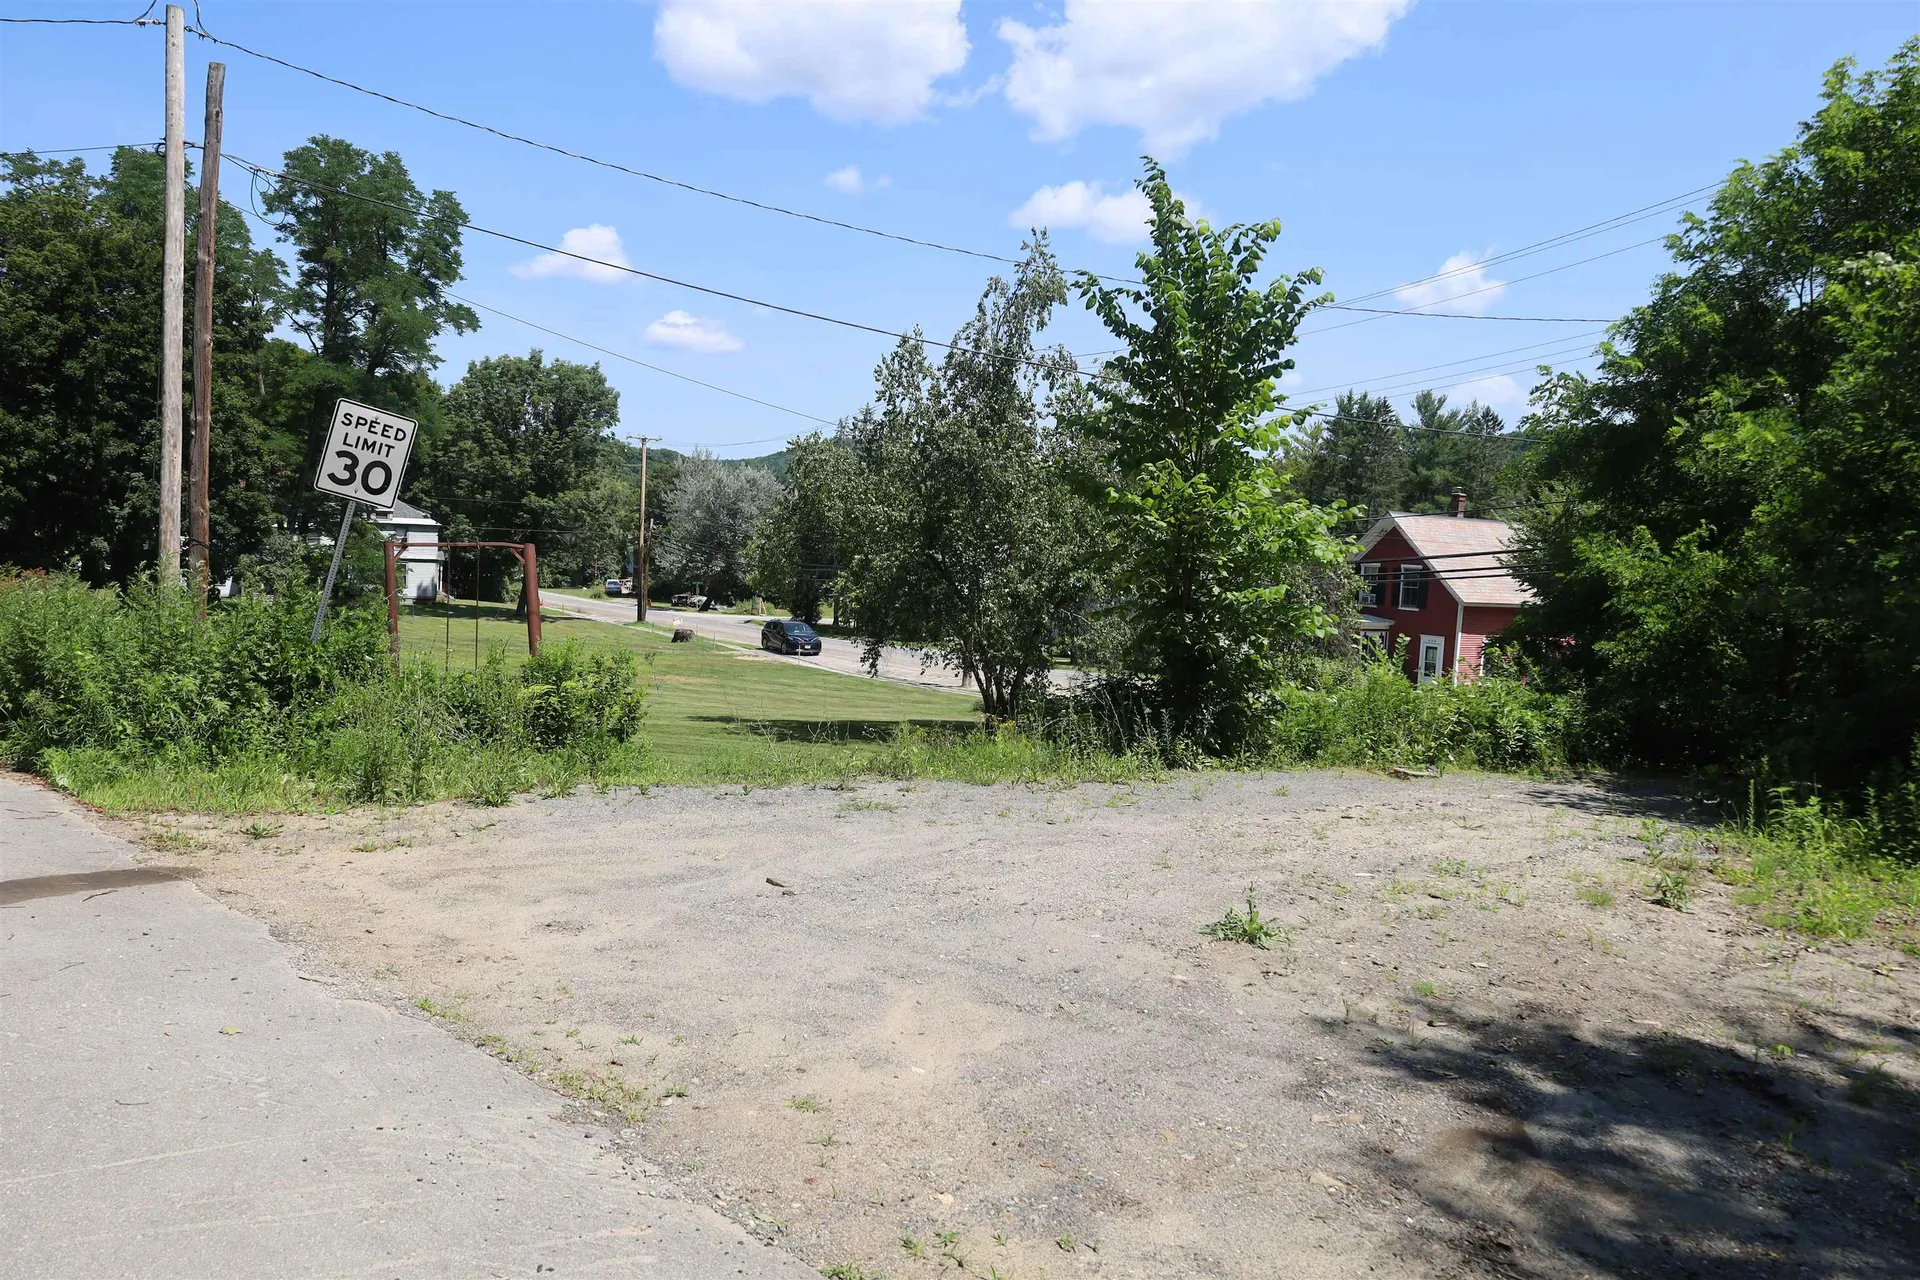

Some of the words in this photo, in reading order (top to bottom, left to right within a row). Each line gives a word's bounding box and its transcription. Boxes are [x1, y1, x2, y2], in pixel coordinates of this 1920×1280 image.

[341, 413, 406, 441] SPEED
[343, 433, 395, 457] LIMIT
[327, 450, 392, 495] 30
